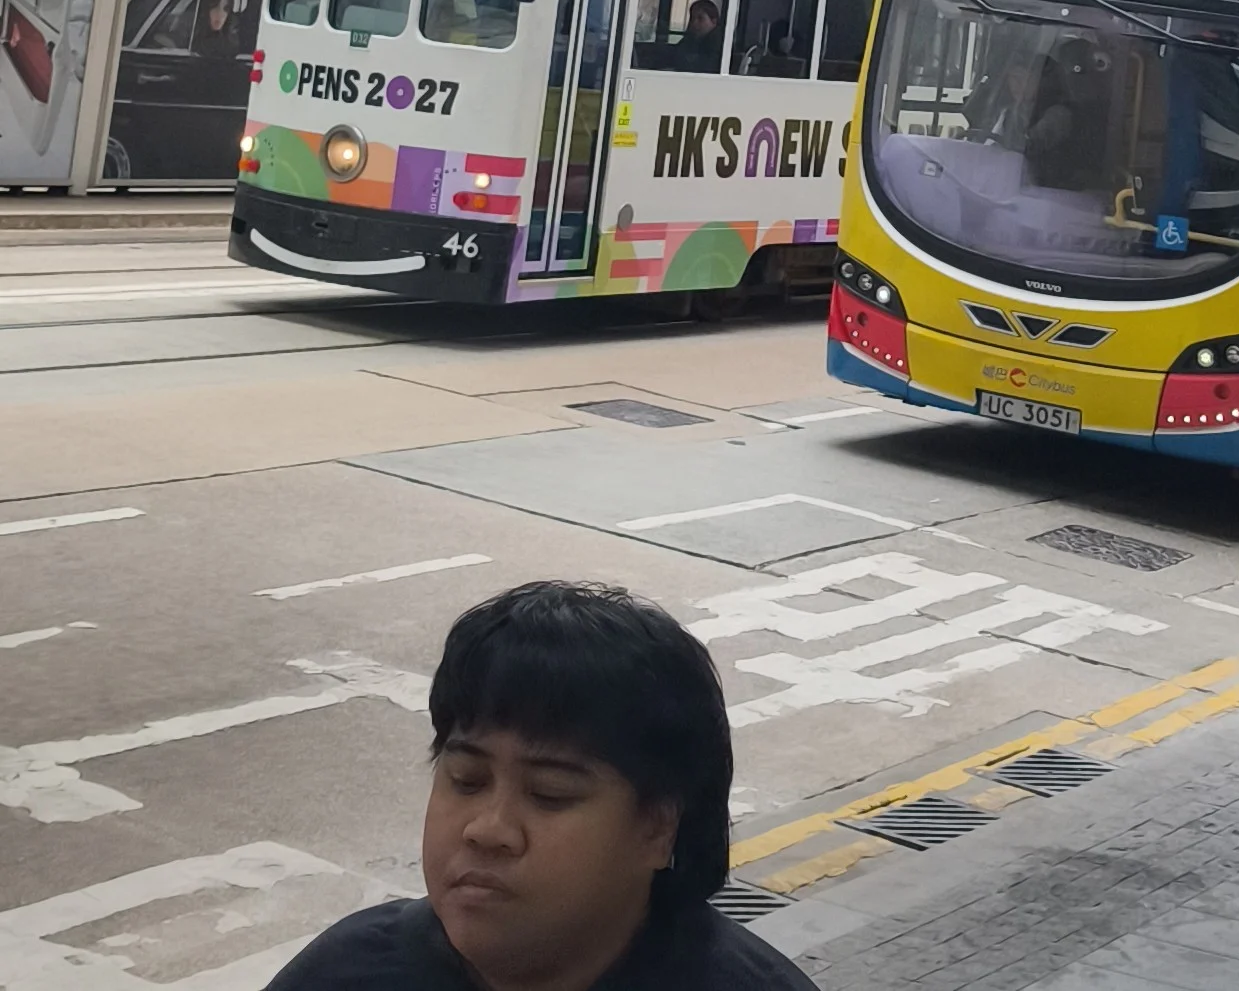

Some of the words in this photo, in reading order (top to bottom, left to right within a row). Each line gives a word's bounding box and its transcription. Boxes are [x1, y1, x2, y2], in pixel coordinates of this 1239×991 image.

[279, 60, 361, 104] OPENS
[364, 72, 460, 116] 2027
[653, 115, 742, 179] HK'S
[744, 118, 833, 178] NEW
[442, 231, 479, 258] 46
[1025, 280, 1062, 293] VOLVO
[1028, 374, 1076, 396] Citybus
[988, 395, 1014, 418] UC
[1022, 404, 1071, 430] 3051
